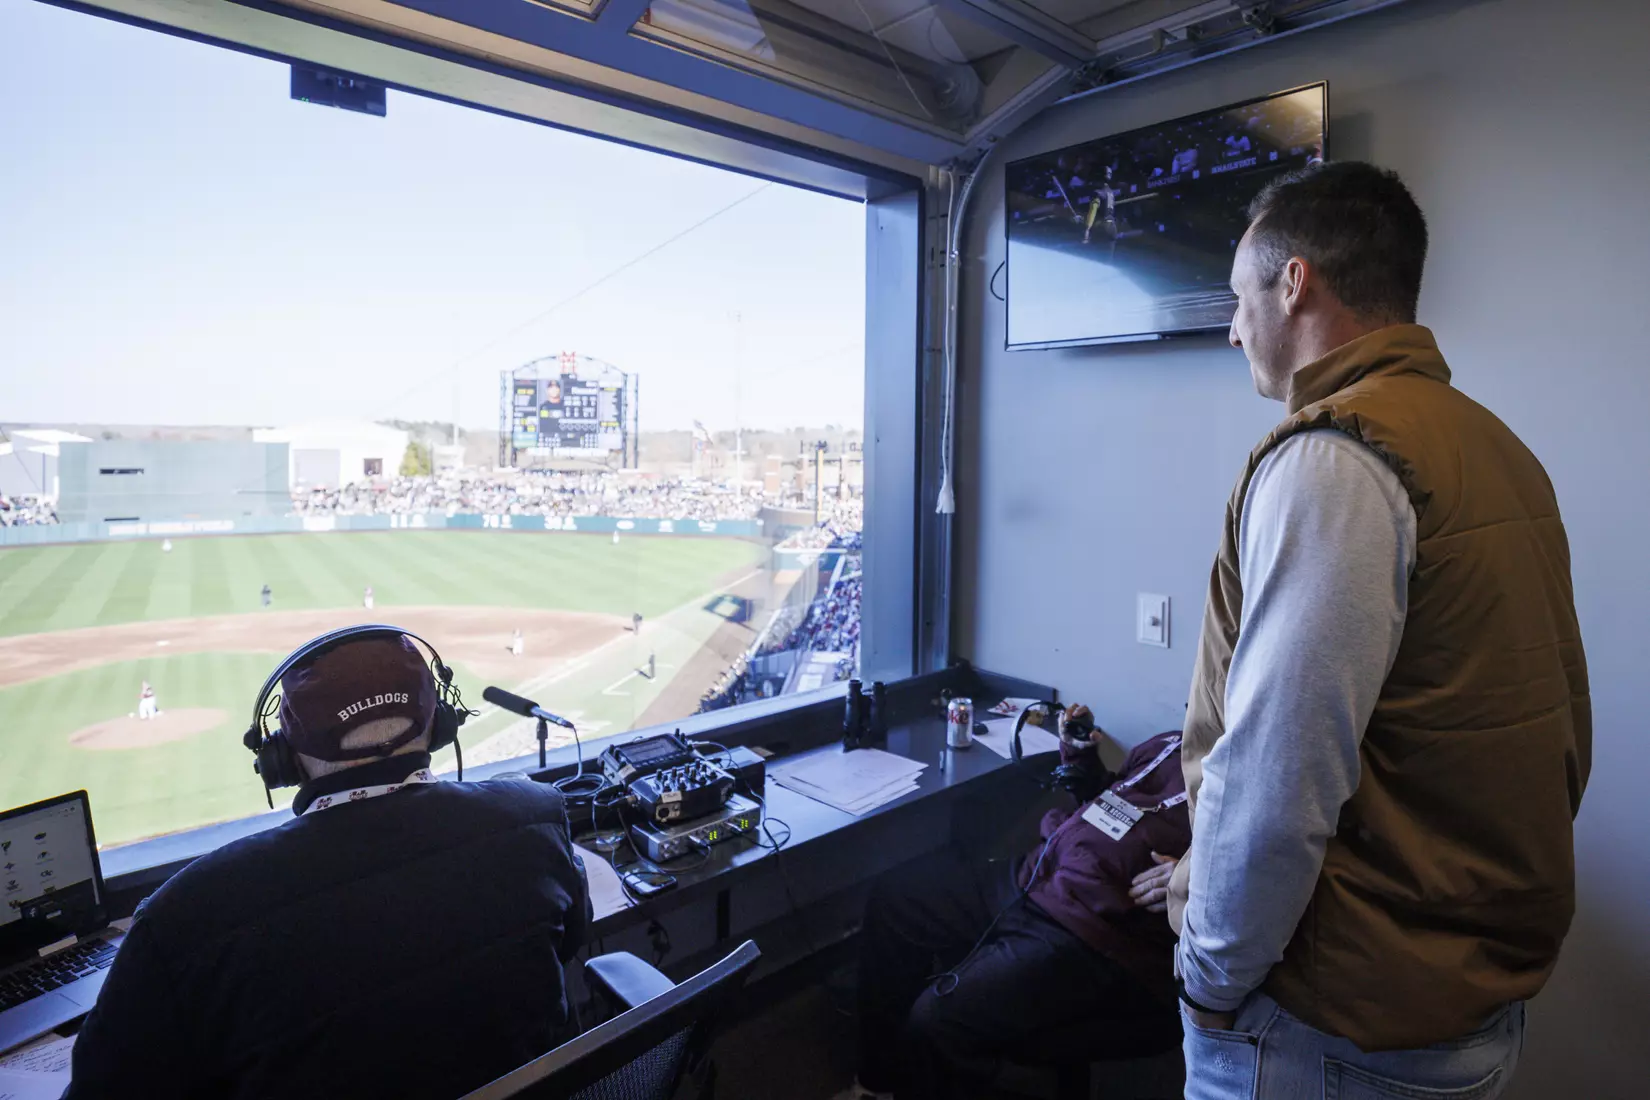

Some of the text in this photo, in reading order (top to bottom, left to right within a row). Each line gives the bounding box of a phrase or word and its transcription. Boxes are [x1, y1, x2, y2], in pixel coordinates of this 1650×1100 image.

[337, 692, 409, 722] BULLDOGS
[1100, 802, 1111, 811] ALL
[1109, 808, 1131, 824] ACCESS
